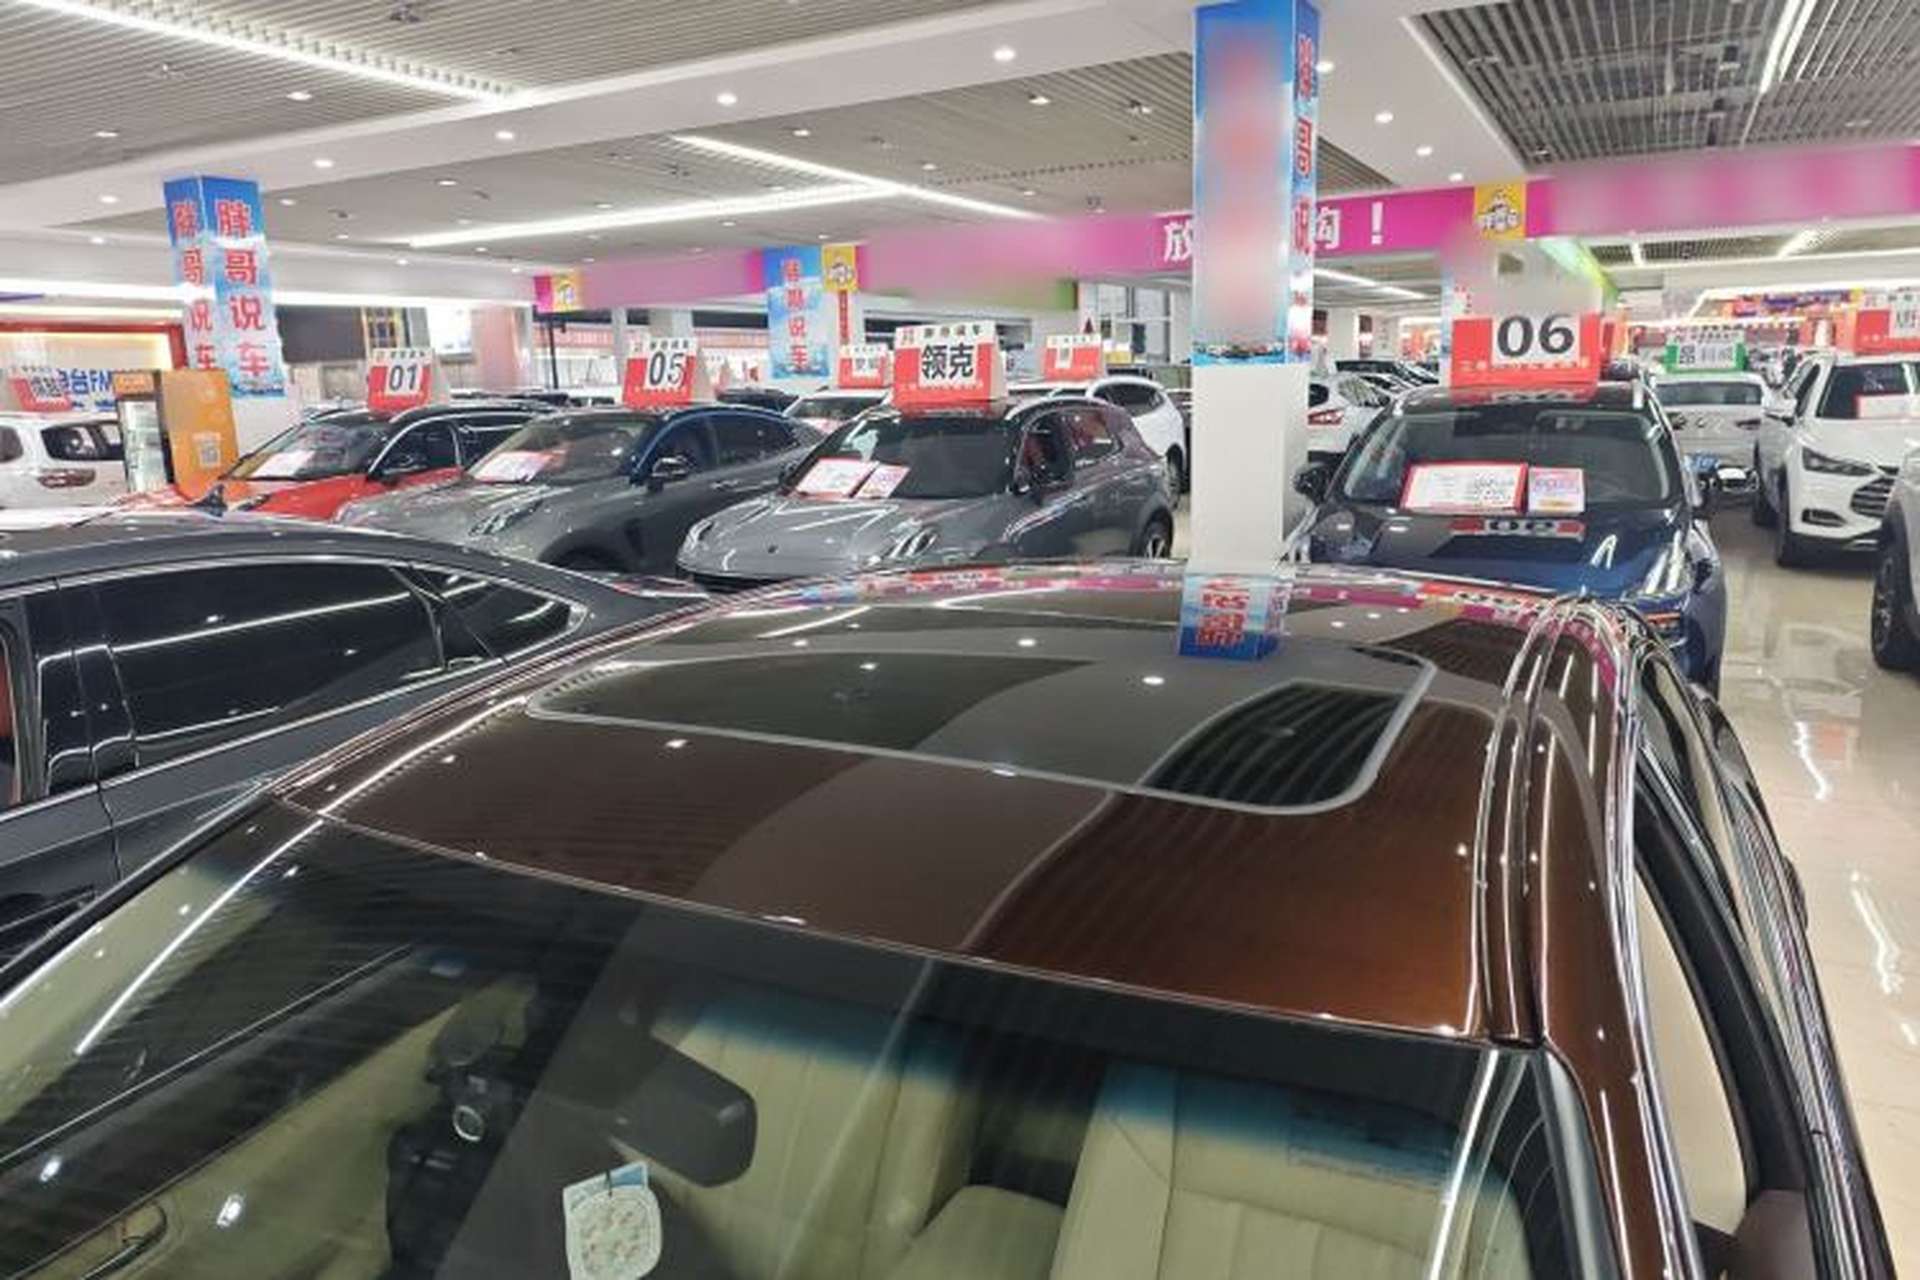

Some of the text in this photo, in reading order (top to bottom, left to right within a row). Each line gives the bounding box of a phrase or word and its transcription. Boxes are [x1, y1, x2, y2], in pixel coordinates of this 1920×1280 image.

[1498, 314, 1574, 357] 06
[389, 363, 417, 391] 01
[650, 351, 686, 389] 05
[921, 342, 974, 379] 领克
